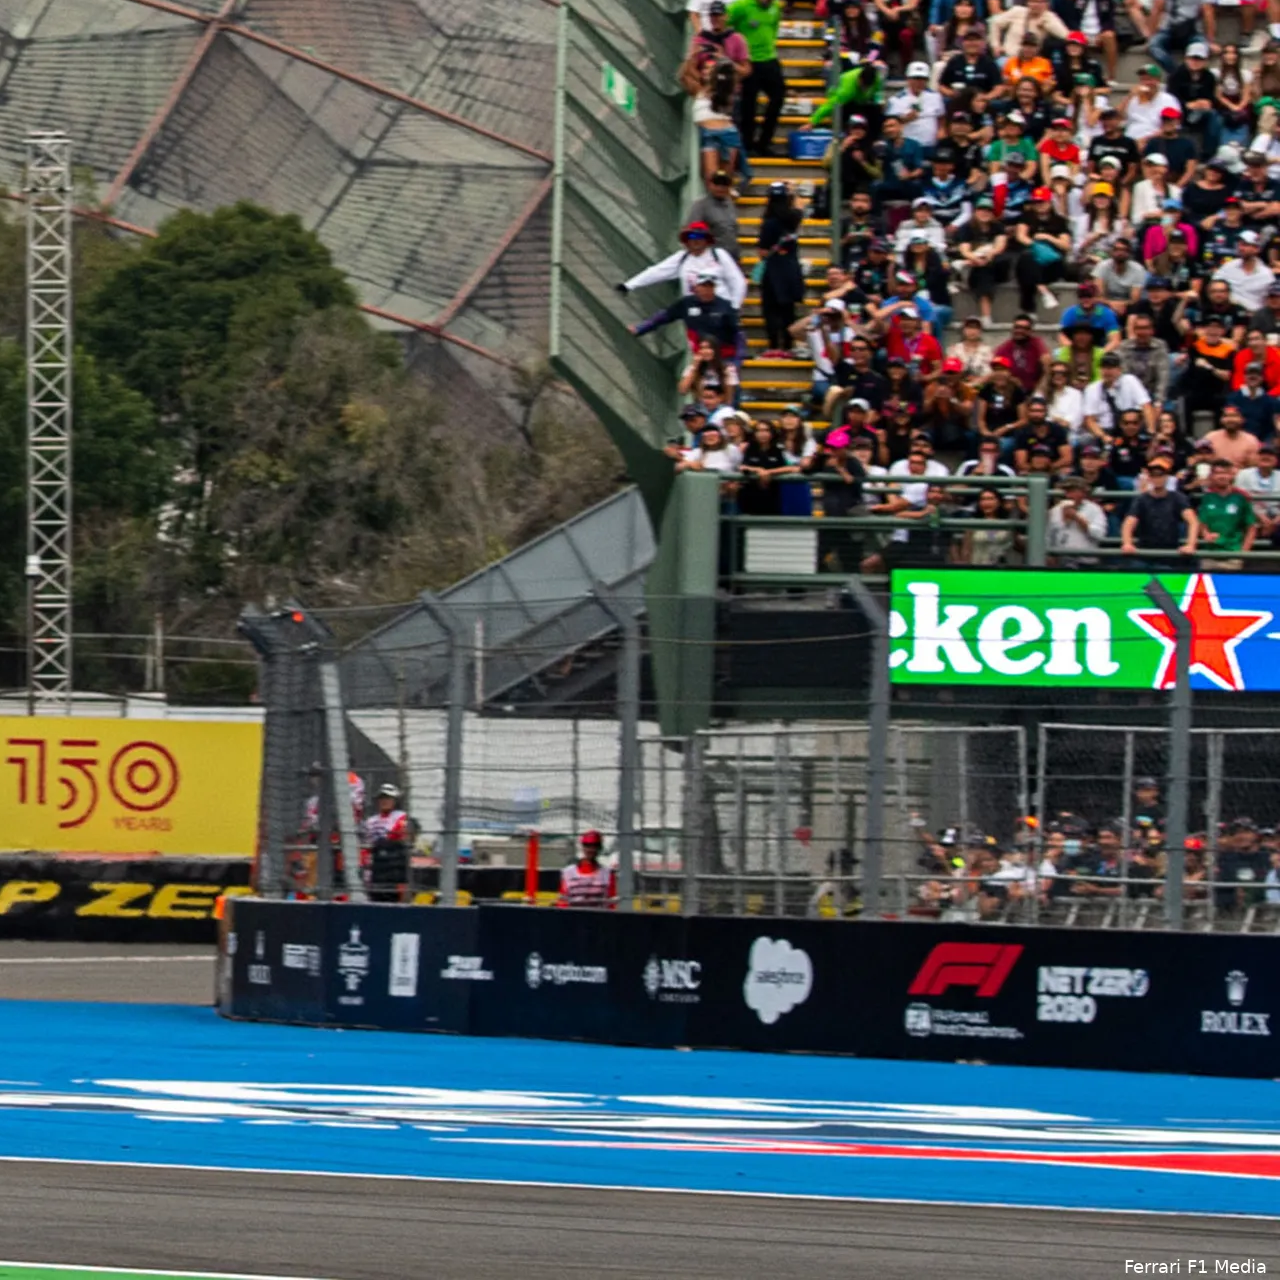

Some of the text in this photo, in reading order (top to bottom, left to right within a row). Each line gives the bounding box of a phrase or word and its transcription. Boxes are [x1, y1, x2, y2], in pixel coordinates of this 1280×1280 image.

[5, 737, 181, 830] 150
[112, 817, 174, 833] YEARS
[1036, 966, 1150, 998] NET ZERO
[1036, 995, 1097, 1023] 2030
[1201, 1010, 1272, 1037] ROLEX
